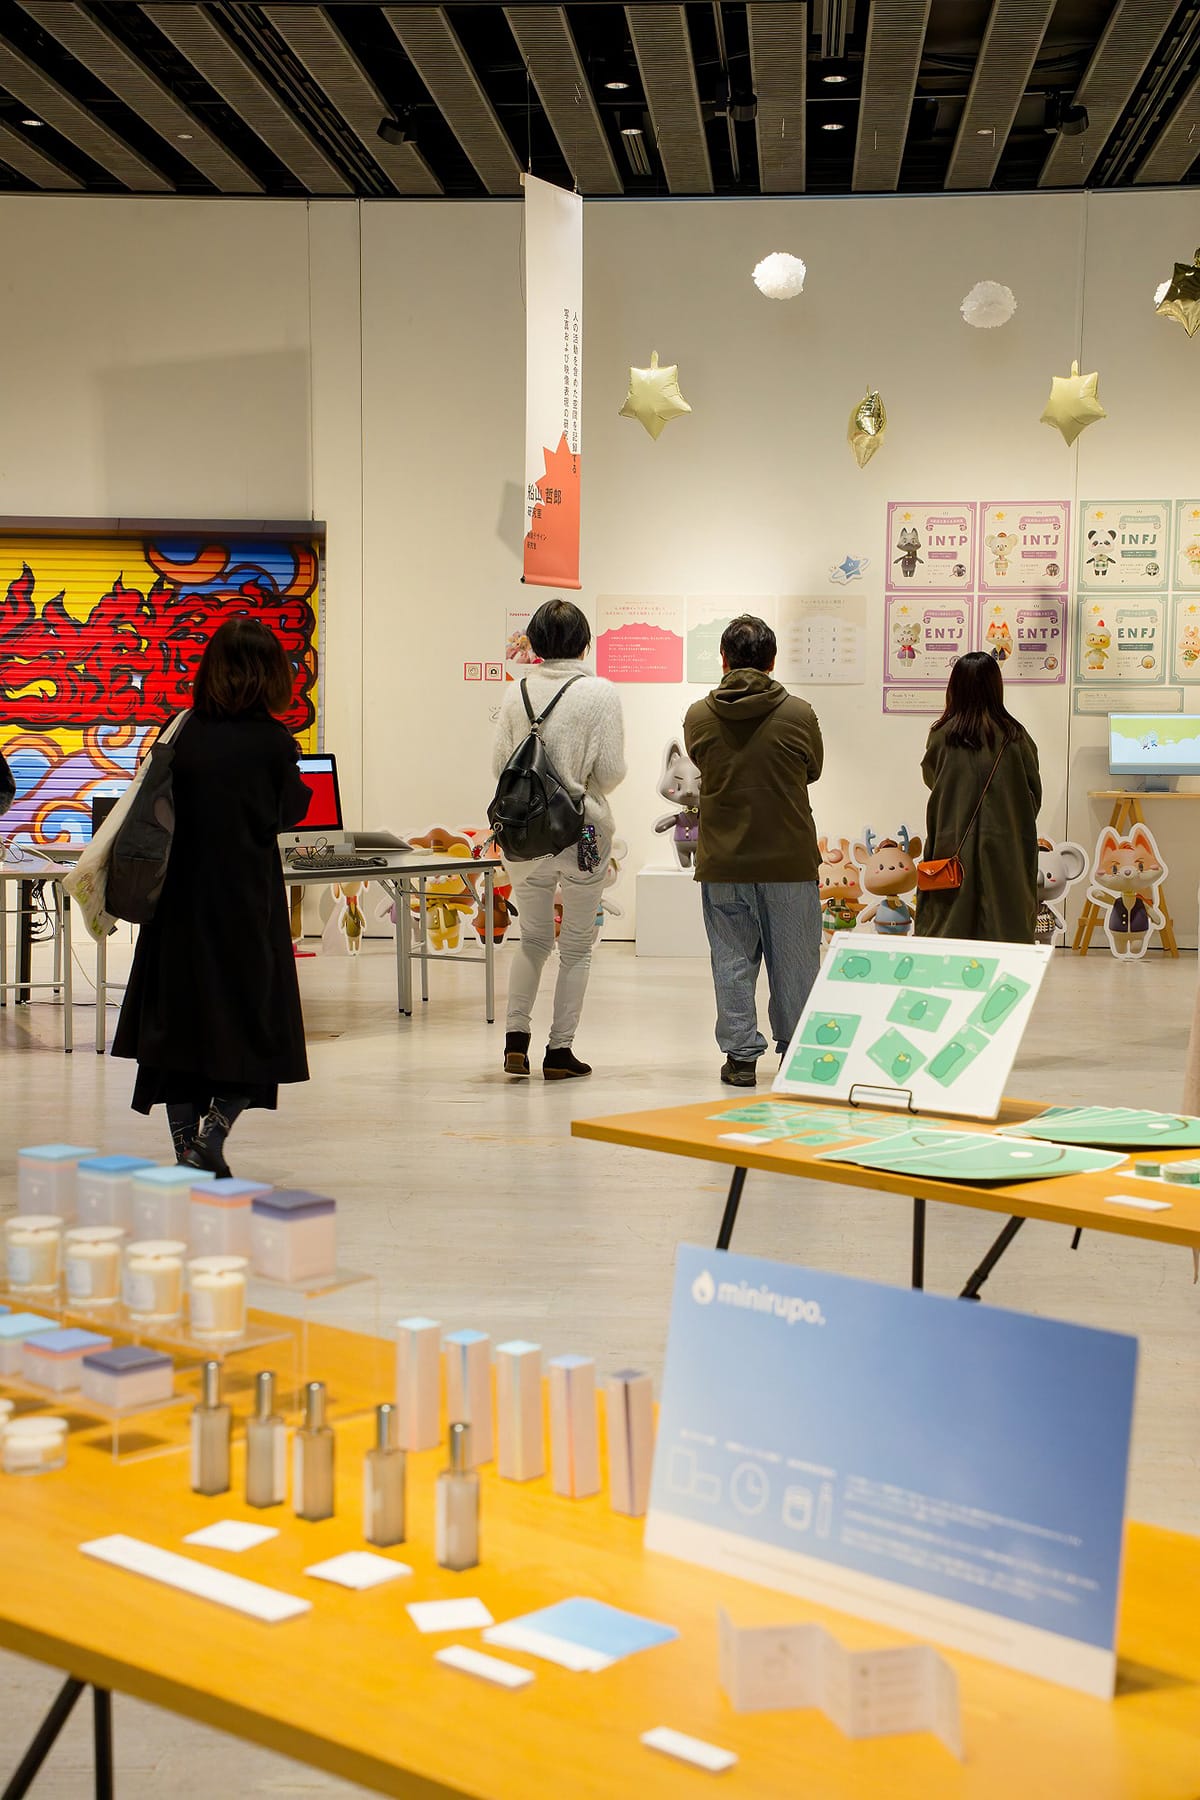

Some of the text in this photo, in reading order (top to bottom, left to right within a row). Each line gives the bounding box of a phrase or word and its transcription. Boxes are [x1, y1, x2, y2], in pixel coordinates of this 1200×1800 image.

[928, 535, 968, 546] INTP
[1022, 534, 1060, 546] INTJ
[1121, 534, 1157, 545] INFJ
[925, 628, 964, 639] ENTJ
[1017, 628, 1060, 639] ENTP
[1117, 627, 1156, 639] ENFJ
